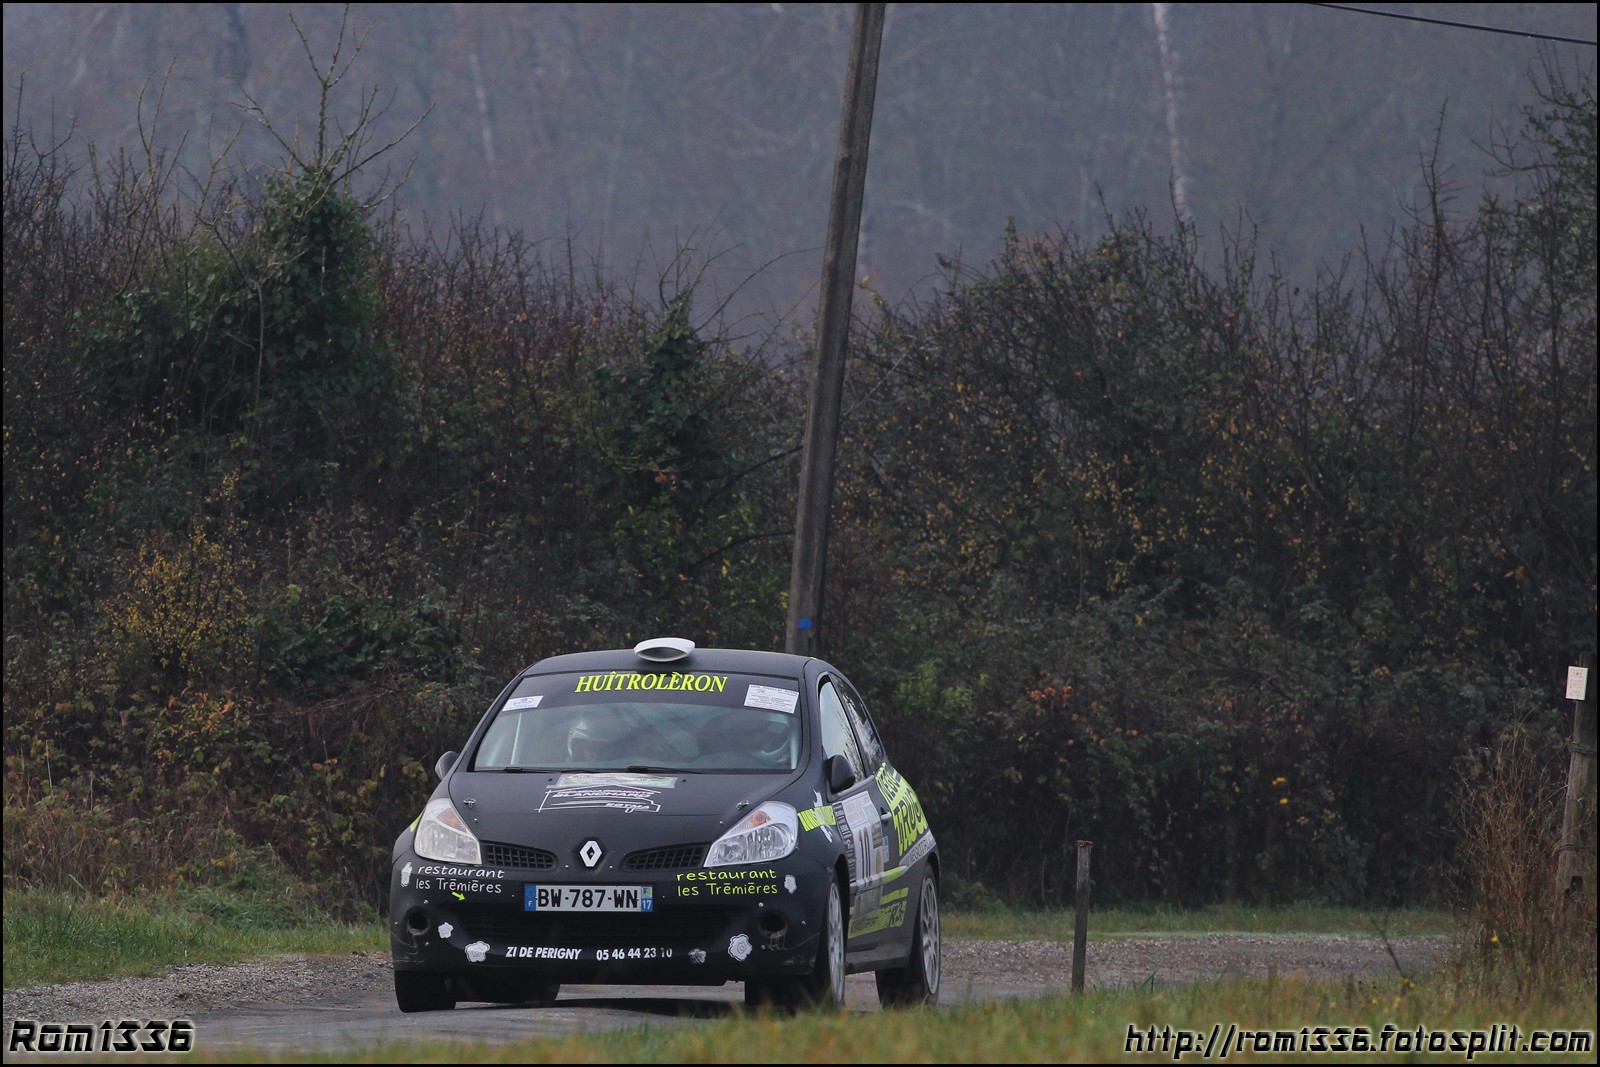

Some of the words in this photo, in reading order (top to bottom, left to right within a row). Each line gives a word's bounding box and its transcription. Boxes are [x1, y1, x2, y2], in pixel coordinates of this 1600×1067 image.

[418, 865, 505, 878] restaurant
[676, 869, 777, 881] restaurant
[415, 878, 431, 890] les
[677, 885, 699, 897] les
[537, 888, 638, 908] BW-787-WN
[642, 899, 652, 910] 17
[506, 946, 517, 957] ZI
[519, 947, 534, 958] DE
[535, 947, 582, 960] PERIGNY
[596, 949, 609, 961] 05
[611, 948, 625, 960] 46
[627, 948, 641, 959] 44
[643, 947, 657, 959] 23
